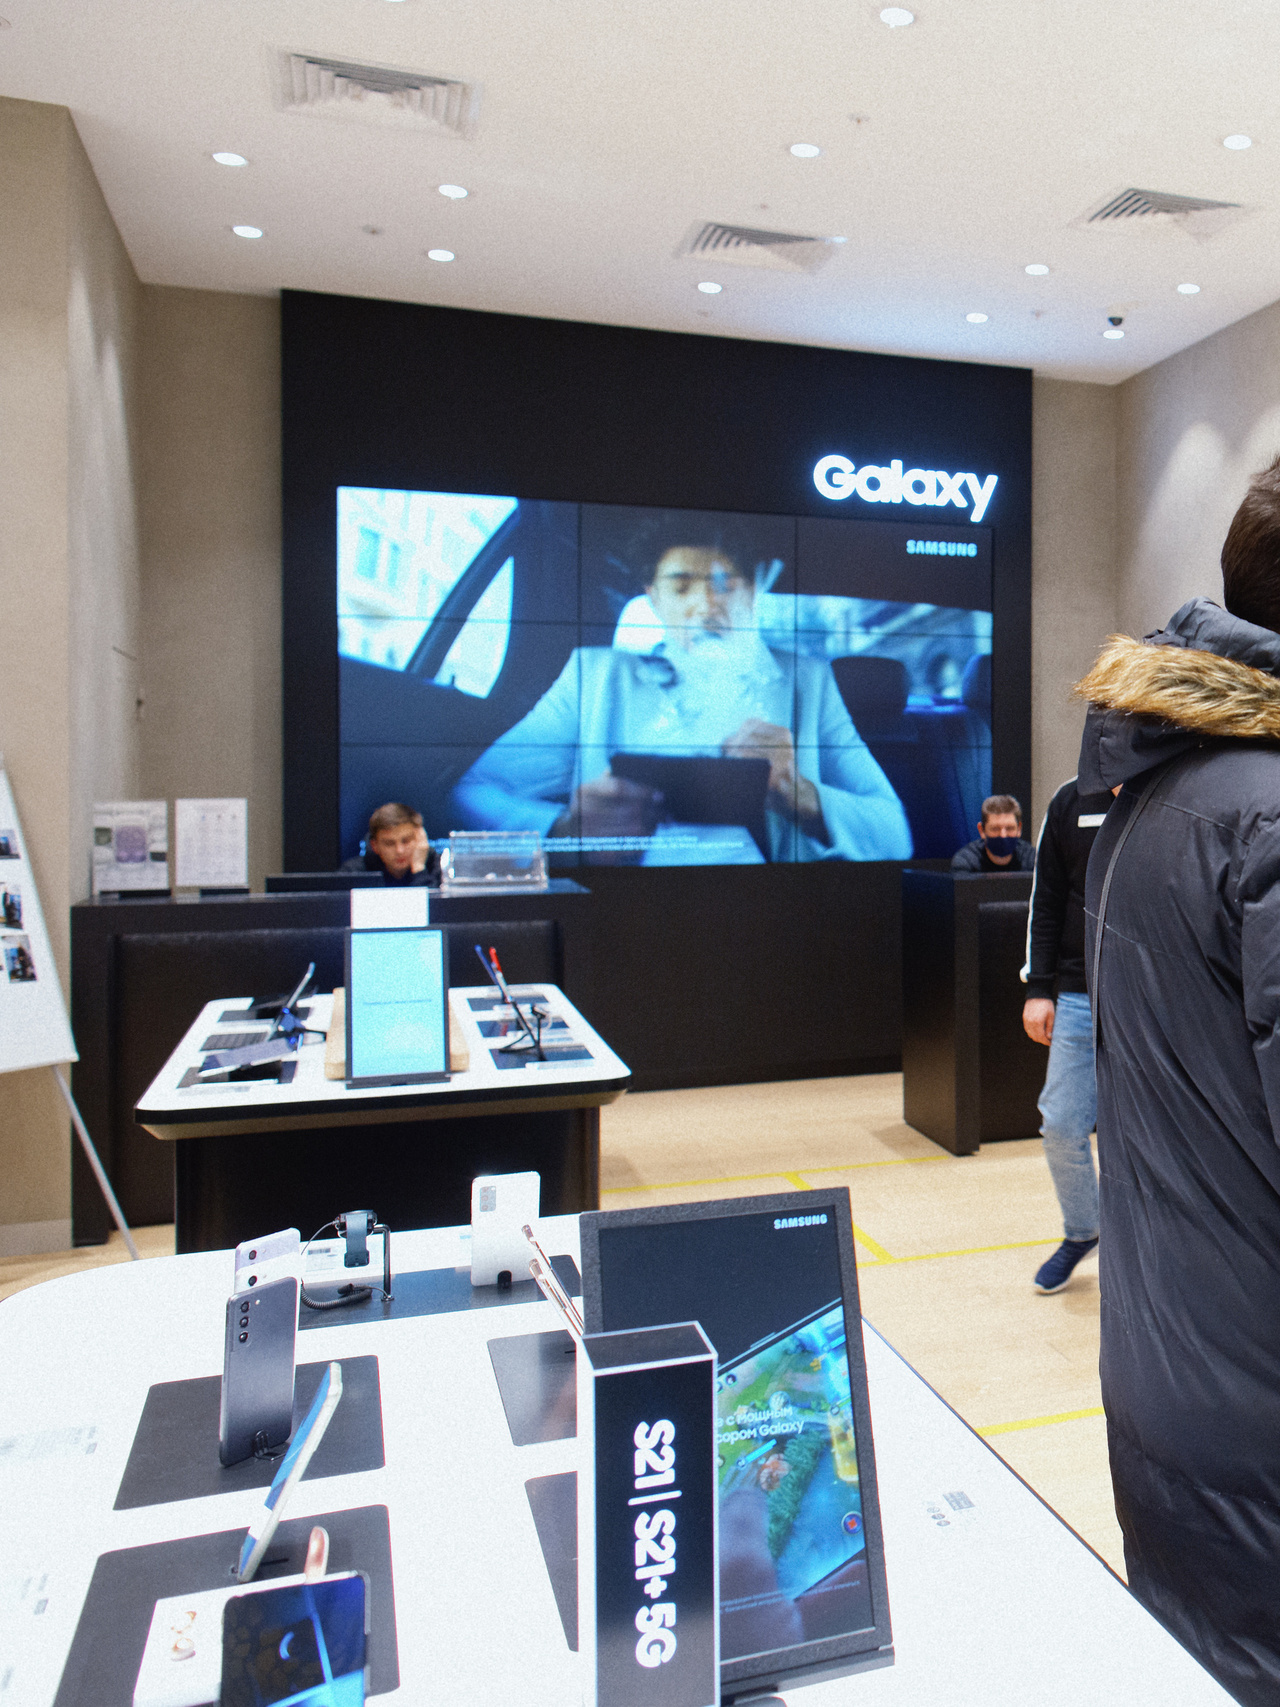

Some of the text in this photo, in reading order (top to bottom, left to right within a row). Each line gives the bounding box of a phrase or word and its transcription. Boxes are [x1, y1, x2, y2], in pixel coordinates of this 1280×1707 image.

[813, 454, 998, 523] Galaxy
[906, 539, 978, 557] SAMSUNG
[773, 1213, 828, 1230] SAMSUNG
[737, 1406, 793, 1425] мощным
[759, 1419, 805, 1438] Galaxy
[634, 1419, 676, 1490] S21
[634, 1509, 677, 1599] S21+
[635, 1602, 678, 1668] 5G
